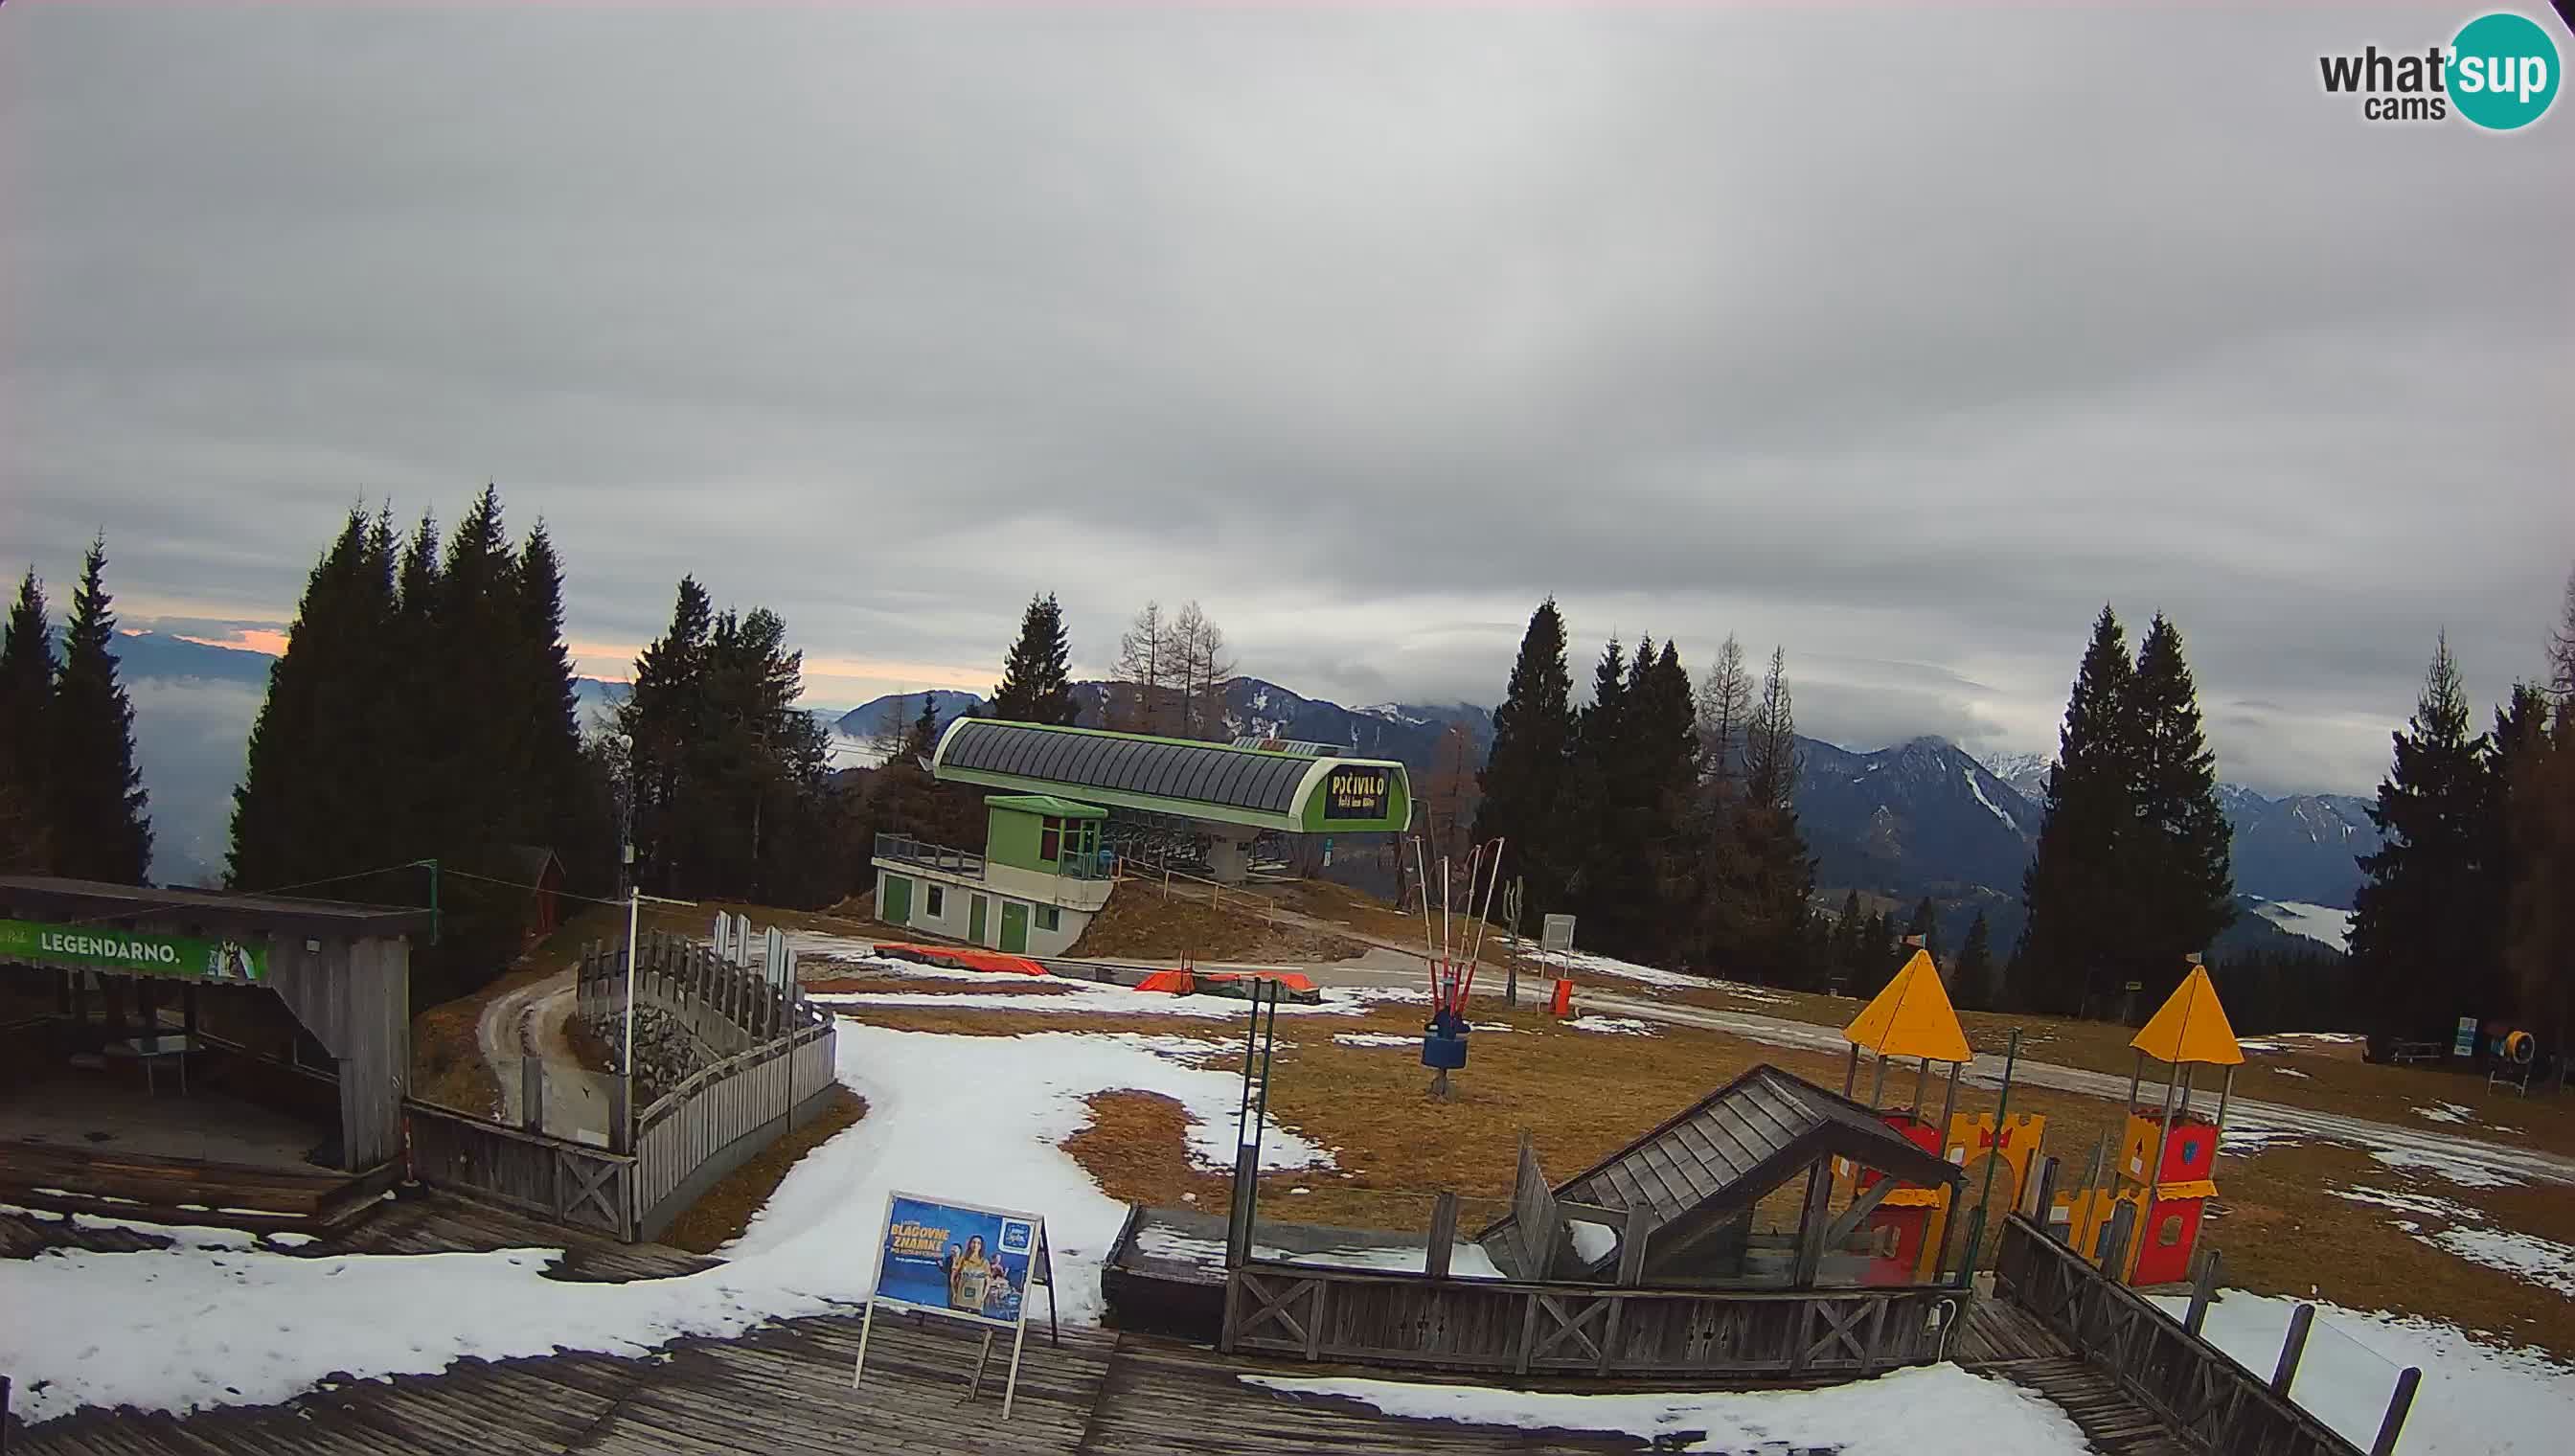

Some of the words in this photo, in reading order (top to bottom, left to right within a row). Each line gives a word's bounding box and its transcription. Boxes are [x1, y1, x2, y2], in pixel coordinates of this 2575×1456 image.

[41, 932, 181, 965] LEGENDARNO.
[891, 1223, 950, 1241] BLAGOVNE
[893, 1236, 944, 1252] ZNAMKE
